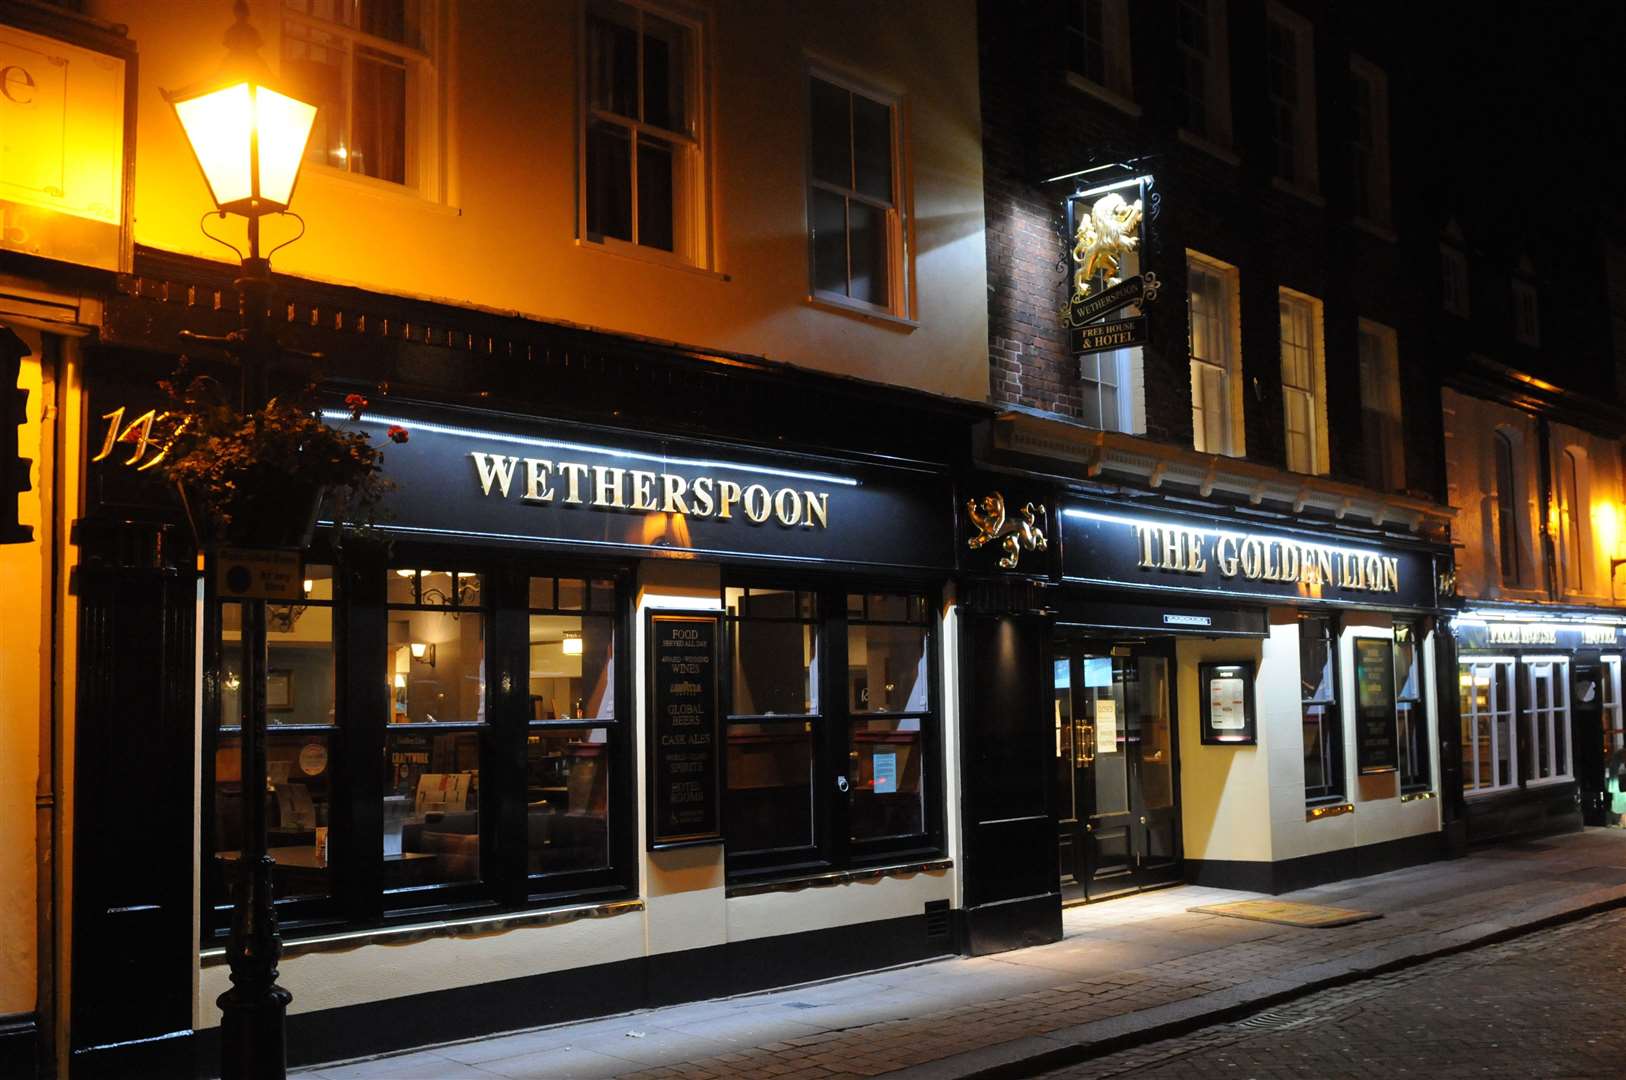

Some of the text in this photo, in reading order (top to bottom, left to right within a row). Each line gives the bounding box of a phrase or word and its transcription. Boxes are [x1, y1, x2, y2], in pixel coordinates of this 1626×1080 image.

[1076, 283, 1139, 319] WETHERSPOON
[1082, 323, 1136, 339] FREE HOUSE
[1082, 331, 1137, 350] & HOTEL
[470, 451, 831, 530] WETHERSPOON
[1134, 524, 1208, 574] THE
[1213, 533, 1333, 587] GOLDEN
[1335, 550, 1401, 594] LION
[672, 629, 699, 640] FOOD
[671, 663, 703, 674] WINES
[667, 703, 705, 715] GLOBAL
